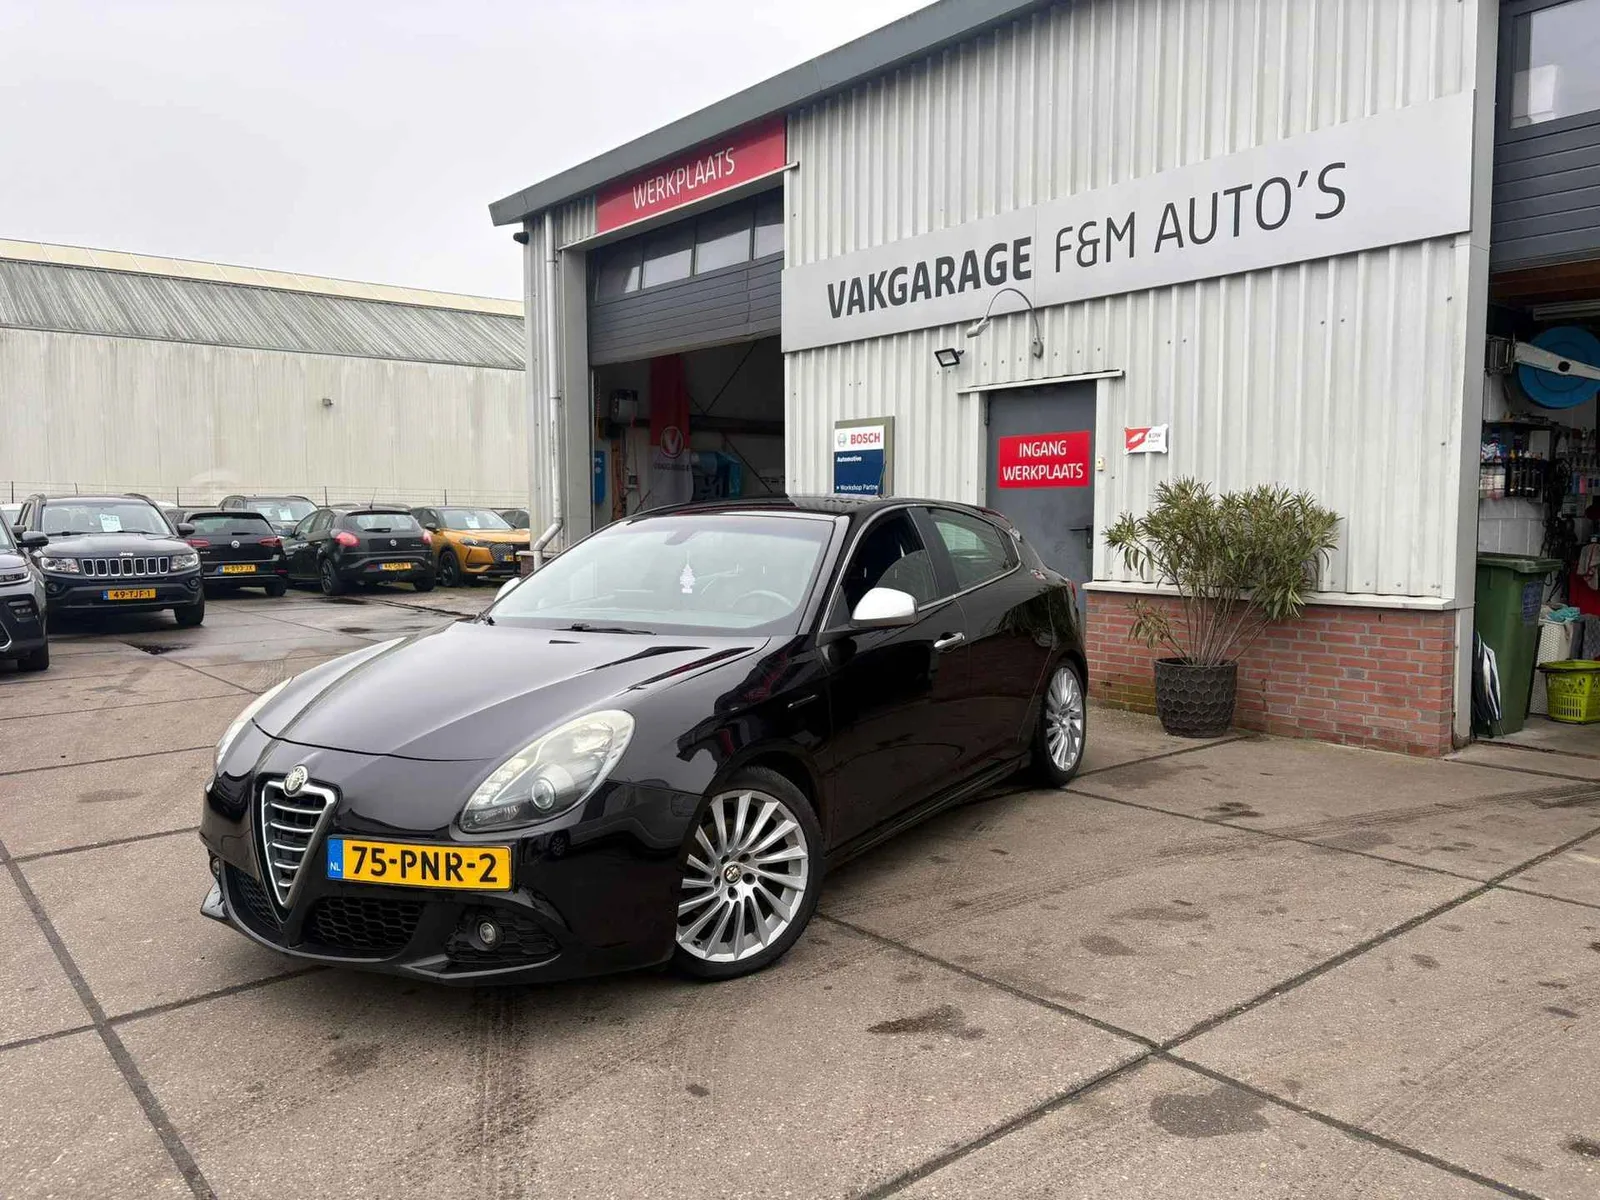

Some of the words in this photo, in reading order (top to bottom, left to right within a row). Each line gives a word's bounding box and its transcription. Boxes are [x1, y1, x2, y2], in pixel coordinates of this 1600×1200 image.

[633, 147, 735, 209] WERKPLAATS
[827, 236, 1032, 319] VAKGARAGE
[1055, 211, 1136, 273] F&M
[1154, 162, 1346, 253] AUTO'S
[849, 432, 881, 445] BOSCH
[1019, 440, 1067, 458] INGANG
[1003, 463, 1084, 481] WERKPLAATS
[840, 484, 862, 492] Workshop
[863, 483, 879, 491] Partne
[113, 590, 152, 599] 49-TJF-1
[330, 861, 341, 872] NL
[352, 846, 498, 883] 75-PNR-2
